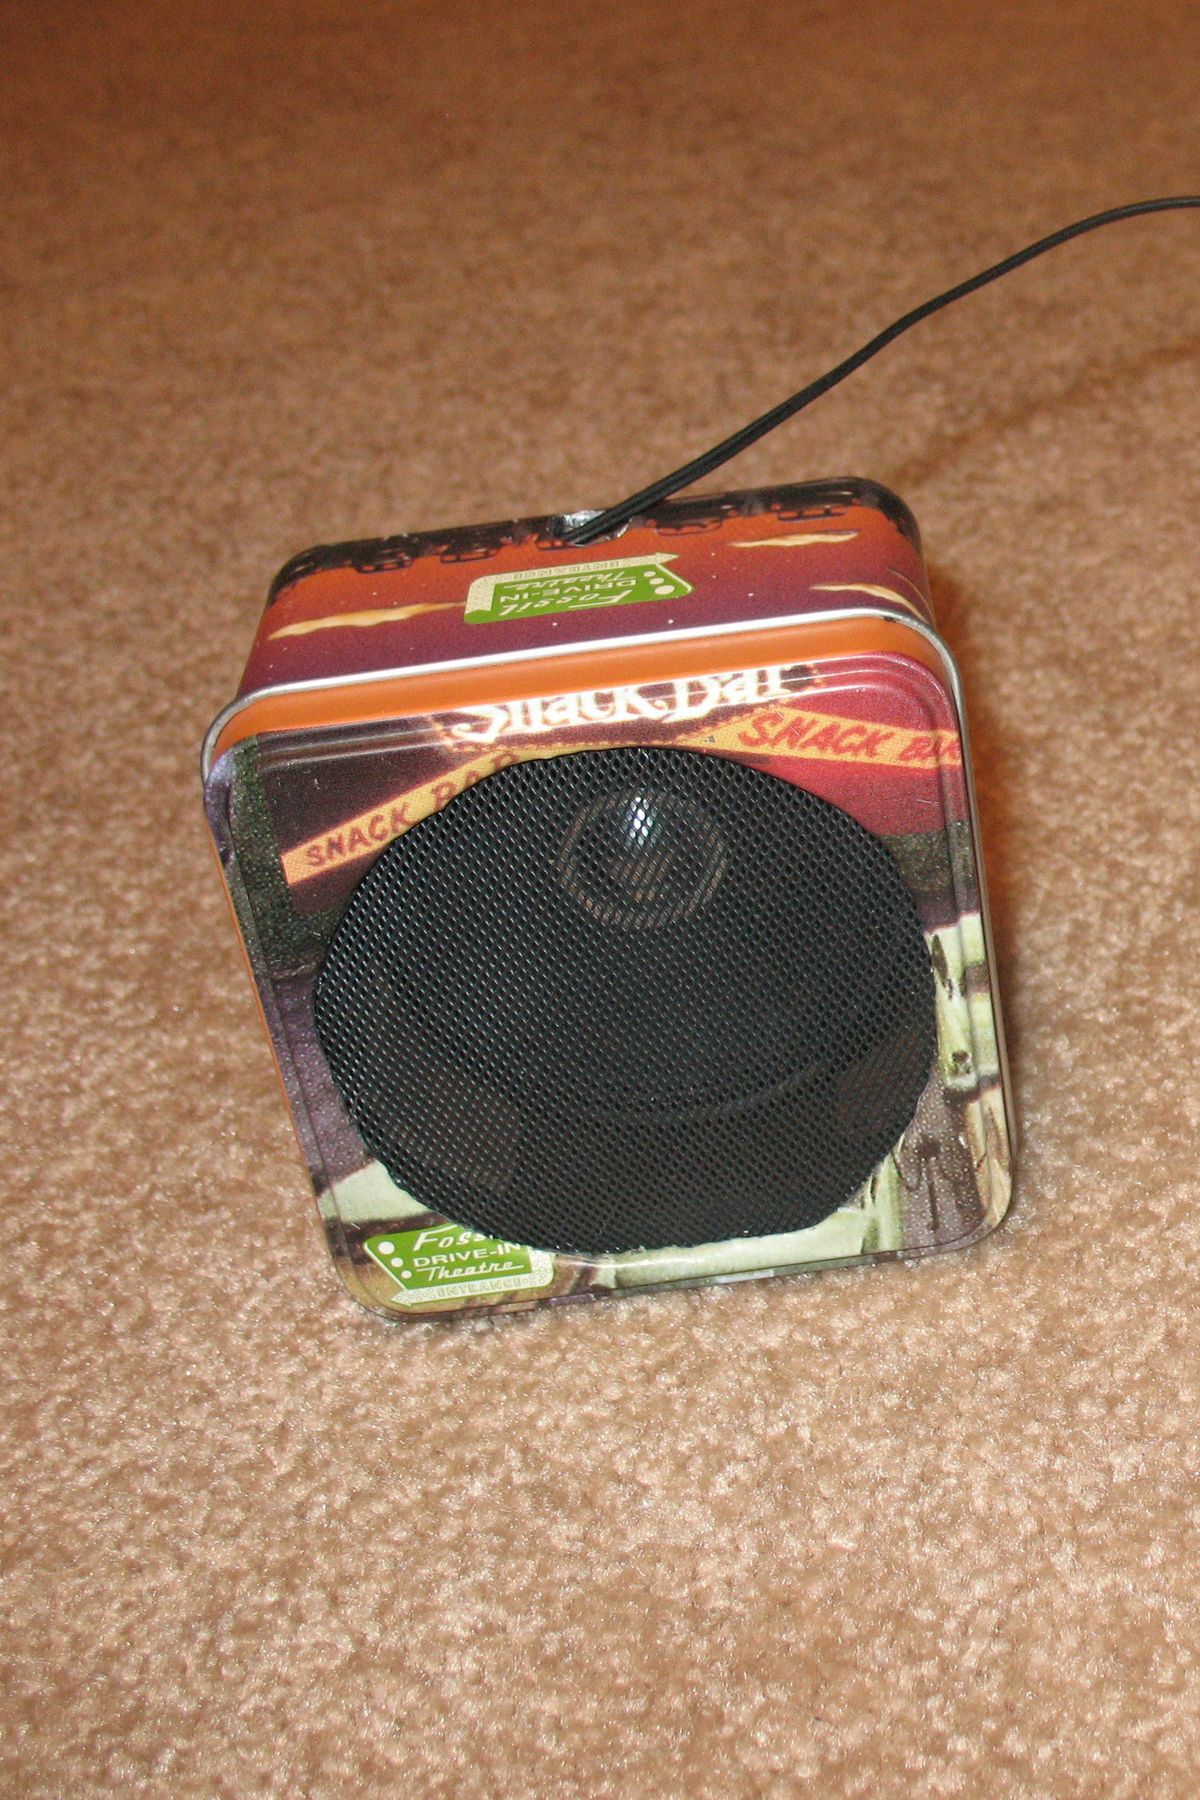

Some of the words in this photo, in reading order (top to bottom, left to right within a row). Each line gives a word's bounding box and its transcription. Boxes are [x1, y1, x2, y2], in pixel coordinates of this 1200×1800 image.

[499, 578, 637, 602] DRIVE-IN
[504, 571, 637, 589] Theatre
[498, 590, 634, 616] Fossil
[741, 711, 897, 758] SNACK
[304, 801, 415, 867] SNACK
[413, 1242, 521, 1267] DRIVE-IN
[416, 1261, 524, 1281] Theatre
